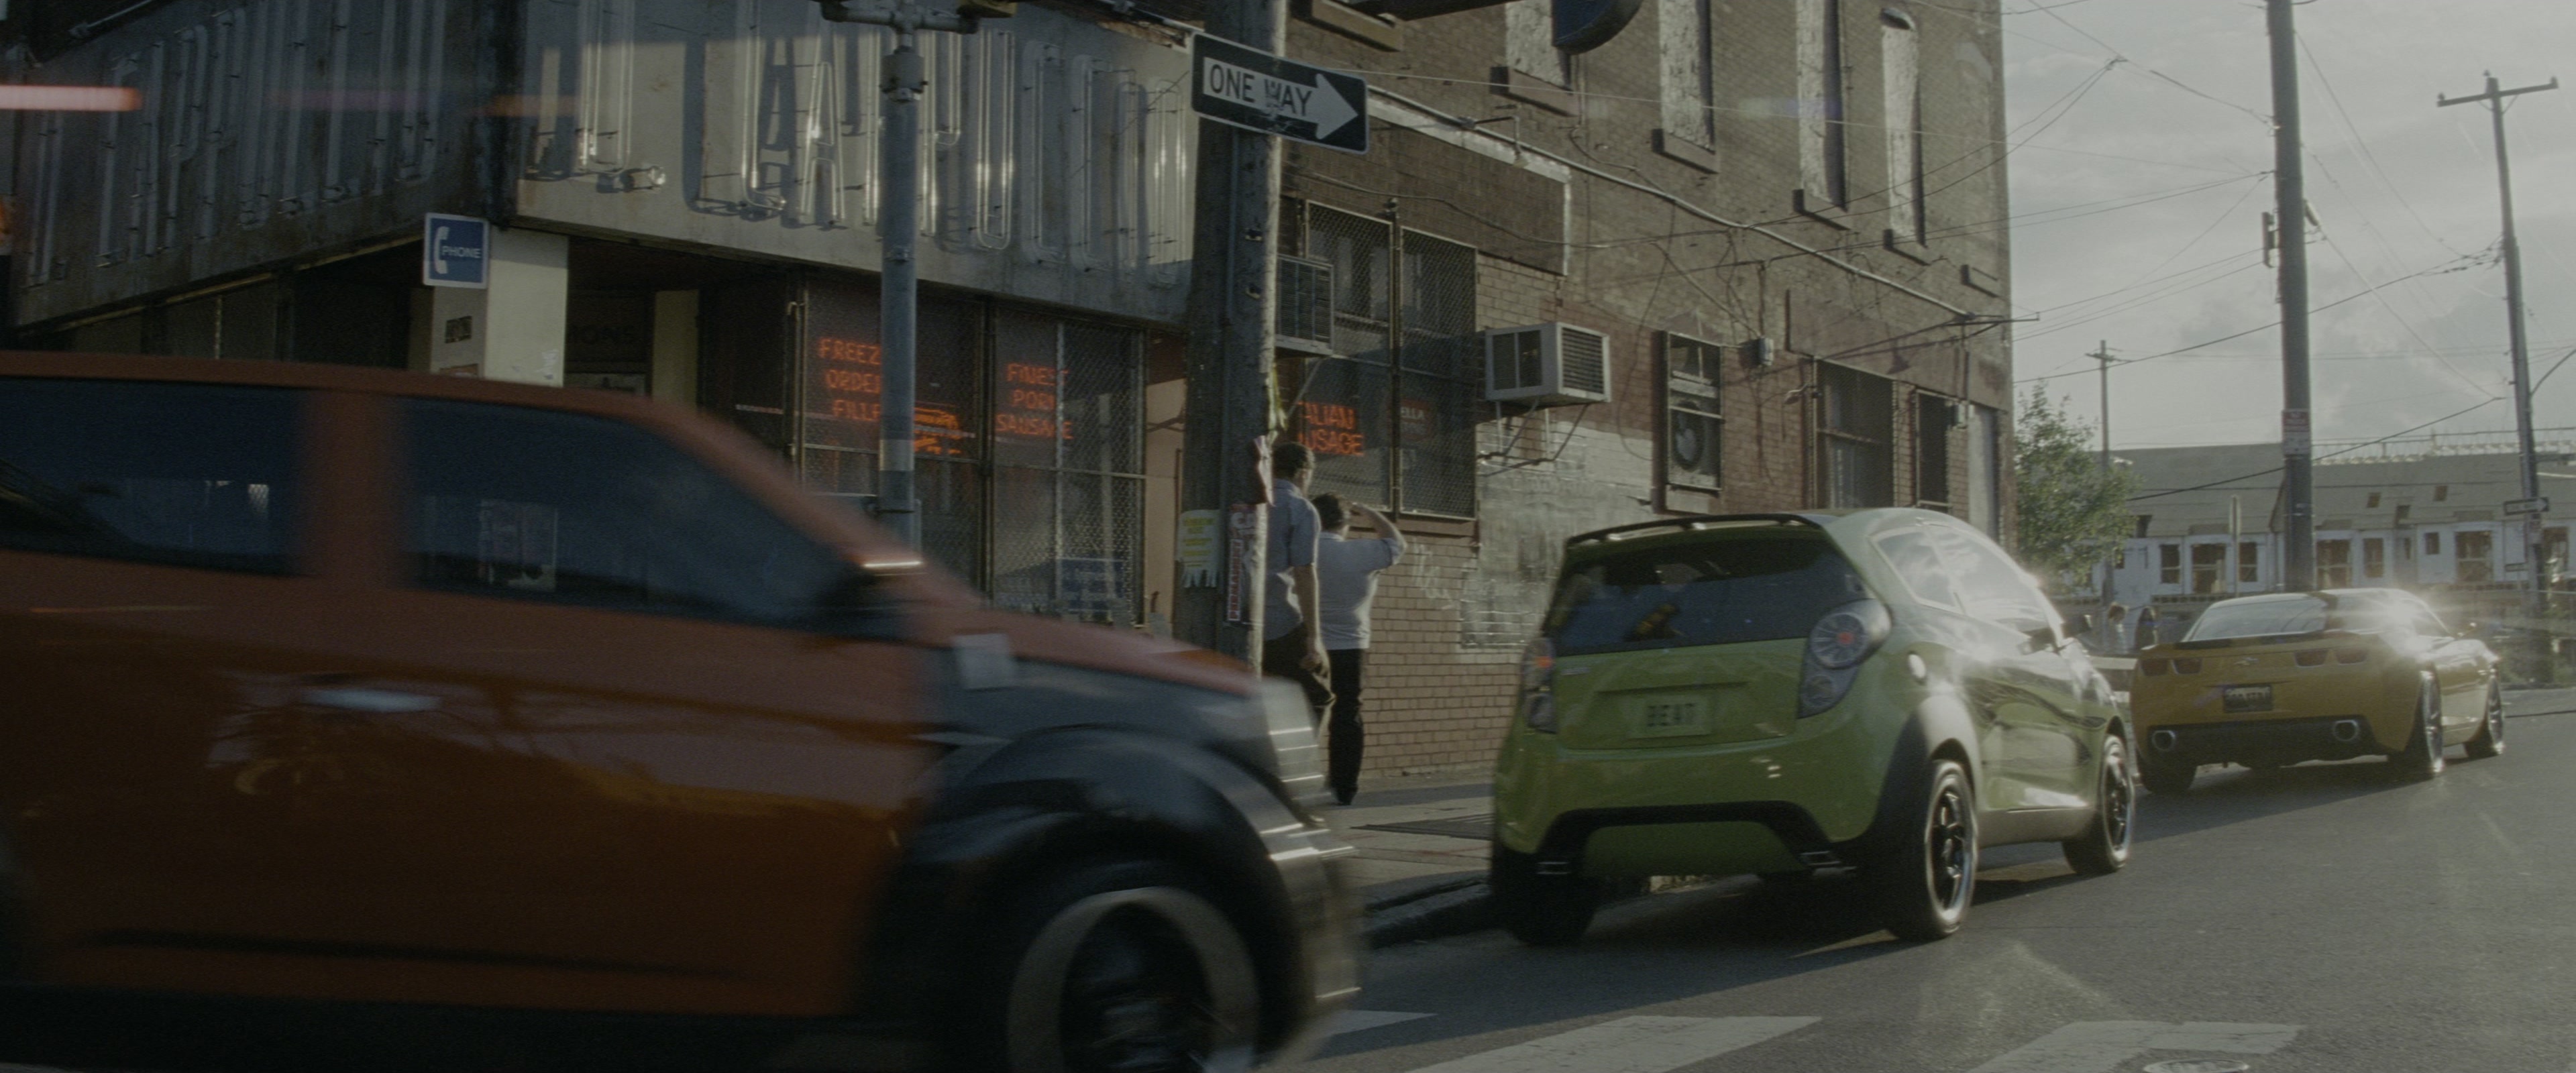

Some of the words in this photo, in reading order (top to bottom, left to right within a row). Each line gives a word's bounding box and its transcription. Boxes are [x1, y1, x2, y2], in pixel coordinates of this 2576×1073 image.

[1210, 64, 1255, 103] ONE
[1265, 78, 1312, 117] WAY
[442, 245, 481, 260] PHONE
[818, 337, 880, 365] FREEZ
[995, 413, 1074, 440] SAUSAE
[1297, 428, 1364, 457] USAGE
[1647, 703, 1695, 728] BEAT
